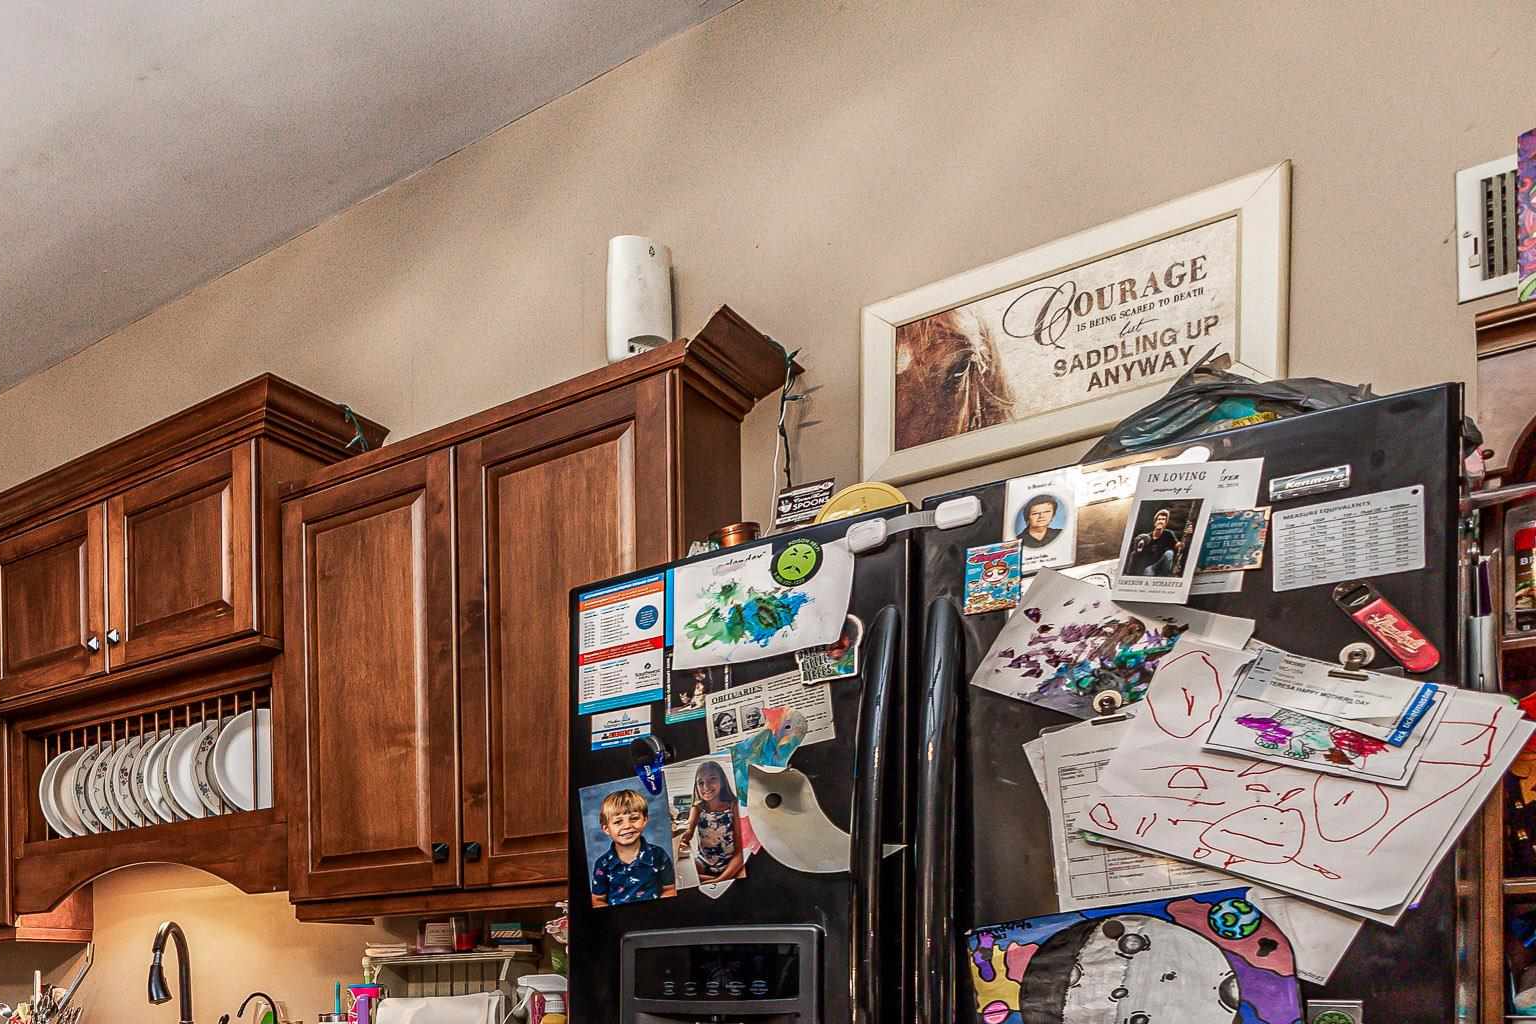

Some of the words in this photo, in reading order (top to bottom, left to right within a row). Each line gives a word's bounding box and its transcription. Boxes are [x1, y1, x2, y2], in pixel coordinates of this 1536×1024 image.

[1002, 255, 1208, 350] COURAGE
[1076, 321, 1086, 333] IS
[1089, 313, 1117, 329] BEING
[1119, 301, 1155, 320] SCARED
[1159, 296, 1171, 308] TO
[1173, 286, 1204, 304] DEATH
[1119, 318, 1160, 338] but
[1053, 327, 1177, 378] SADDLING
[1186, 314, 1220, 340] UP
[1087, 345, 1195, 392] ANYWAY
[1148, 473, 1160, 482] IN
[1163, 471, 1207, 482] LOVING
[1285, 473, 1346, 489] Kenmore
[1283, 509, 1318, 520] MEASURE
[1320, 501, 1371, 514] EQUIVALENTS
[711, 685, 763, 704] OBITUARIES
[1269, 680, 1295, 692] TERESA
[1296, 686, 1319, 696] HAPPY
[1355, 698, 1371, 706] DAY
